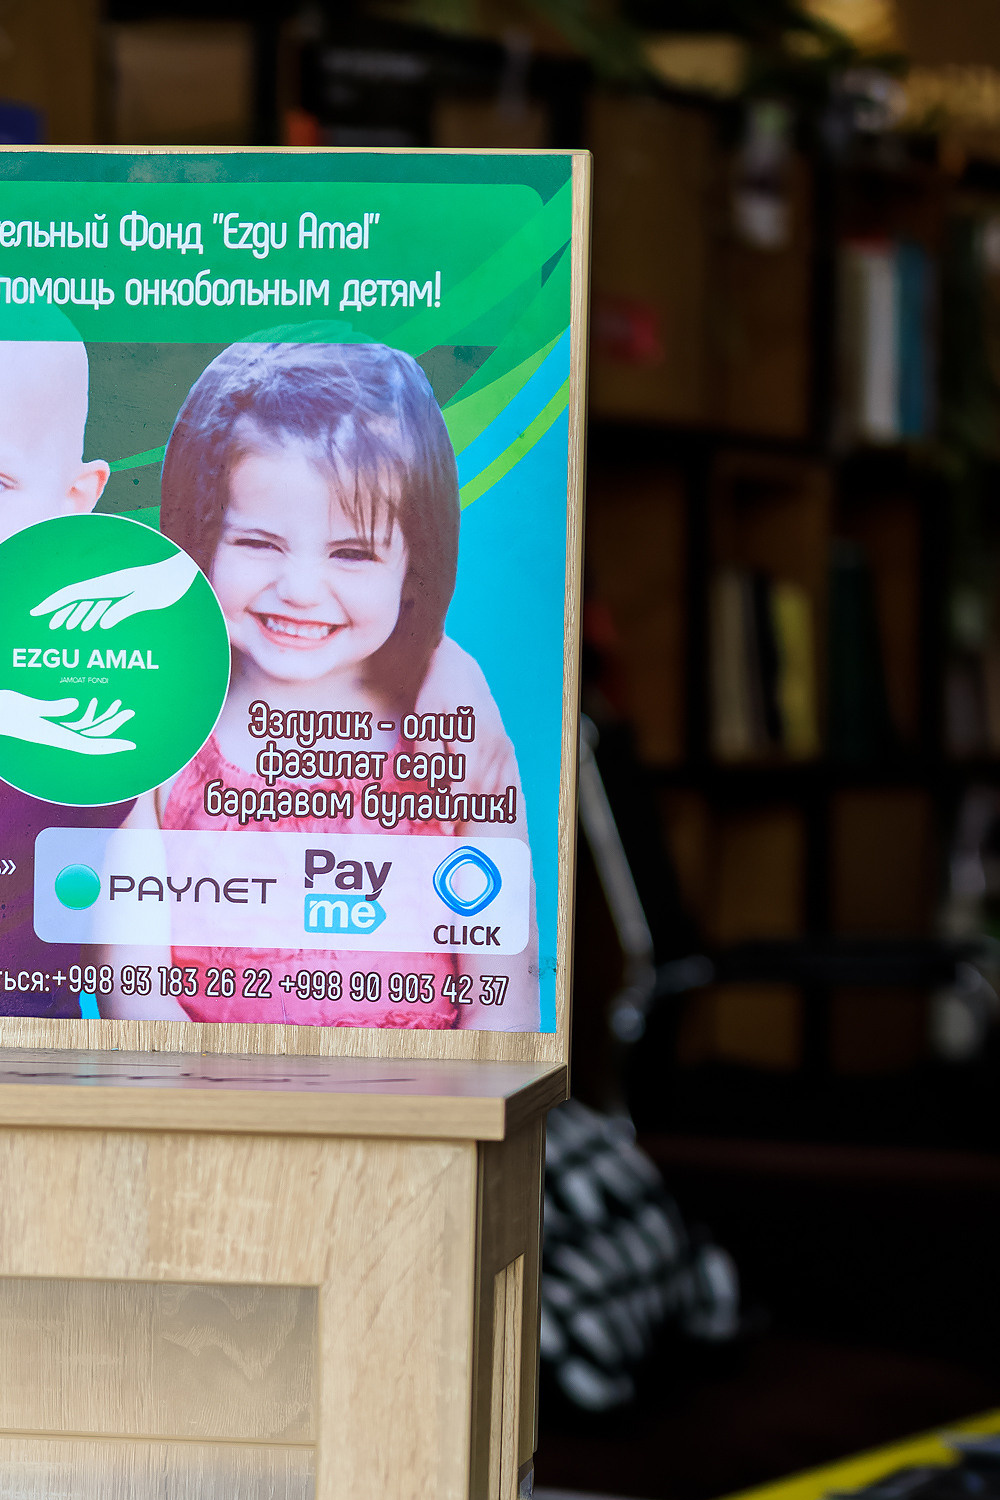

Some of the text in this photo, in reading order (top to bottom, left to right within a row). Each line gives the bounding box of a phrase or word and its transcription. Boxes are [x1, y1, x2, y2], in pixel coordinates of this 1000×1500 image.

[119, 210, 204, 255] Фонд
[212, 211, 287, 259] "Ezgu
[298, 211, 381, 250] Amal"
[125, 268, 330, 307] онкобольным
[338, 270, 442, 312] детям!
[12, 647, 160, 670] EZGU AMAL
[59, 676, 86, 684] JAMOAT
[250, 702, 371, 746] Эзгулик
[402, 708, 474, 742] олий
[258, 742, 465, 788] фазилат сари
[205, 781, 516, 828] бардавом булайлик!
[108, 874, 278, 905] PAYNET
[304, 848, 393, 902] Pay
[307, 900, 377, 929] me
[432, 925, 501, 947] CLICK
[121, 965, 151, 996] 93
[158, 965, 198, 997] 183
[205, 966, 235, 998] 26
[241, 967, 272, 999] 22
[279, 968, 343, 1001] +998
[349, 970, 380, 1001] 90
[388, 971, 434, 1003] 903
[440, 973, 473, 1004] 42
[479, 974, 509, 1006] 37
